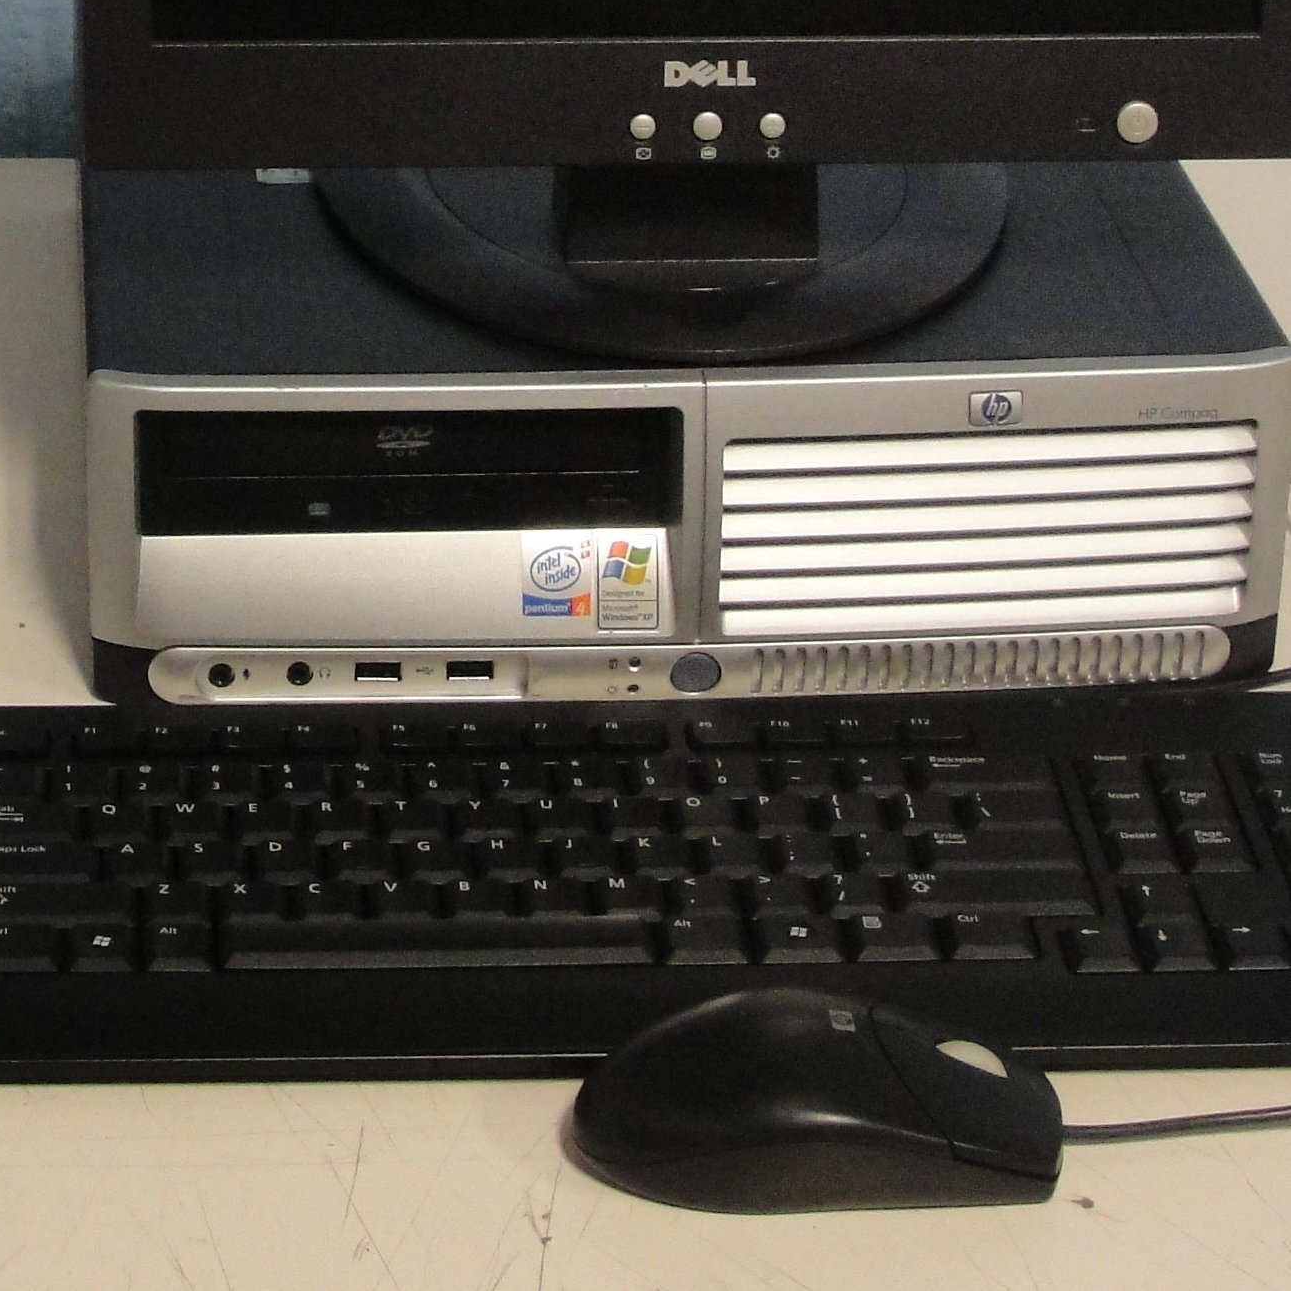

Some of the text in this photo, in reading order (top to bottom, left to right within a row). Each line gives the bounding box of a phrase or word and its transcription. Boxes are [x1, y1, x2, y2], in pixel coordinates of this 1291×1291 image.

[664, 60, 756, 87] DELL
[1137, 407, 1218, 420] HP Compaq
[377, 426, 433, 440] DVD
[537, 552, 561, 574] intel
[545, 563, 576, 585] inside
[524, 603, 568, 614] pentium
[602, 613, 639, 621] Windows
[534, 722, 547, 730] F7
[770, 720, 790, 728] F10
[928, 755, 985, 764] Backspace
[1164, 753, 1186, 761] End
[394, 800, 407, 811] T
[468, 800, 481, 810] Y
[539, 799, 553, 810] U
[685, 796, 701, 807] O
[758, 795, 770, 806] P
[101, 804, 116, 815] Q
[175, 803, 195, 813] W
[248, 802, 258, 813] E
[321, 801, 333, 812] R
[711, 835, 722, 847] L
[933, 832, 964, 840] Enter
[1119, 831, 1157, 840] Delete
[193, 842, 204, 853] S
[269, 841, 282, 852] D
[342, 841, 352, 851] F
[417, 841, 431, 851] G
[490, 839, 504, 850] H
[565, 838, 573, 849] J
[638, 837, 651, 848] K
[20, 845, 46, 853] Lock
[120, 843, 135, 854] A
[907, 873, 936, 881] Shift
[233, 883, 247, 894] X
[308, 883, 321, 894] C
[383, 881, 398, 893] V
[458, 881, 471, 892] B
[533, 879, 547, 890] N
[608, 877, 626, 889] M
[158, 883, 170, 895] Z
[673, 919, 692, 928] Alt
[957, 914, 979, 923] Ctrl
[159, 926, 177, 935] Alt
